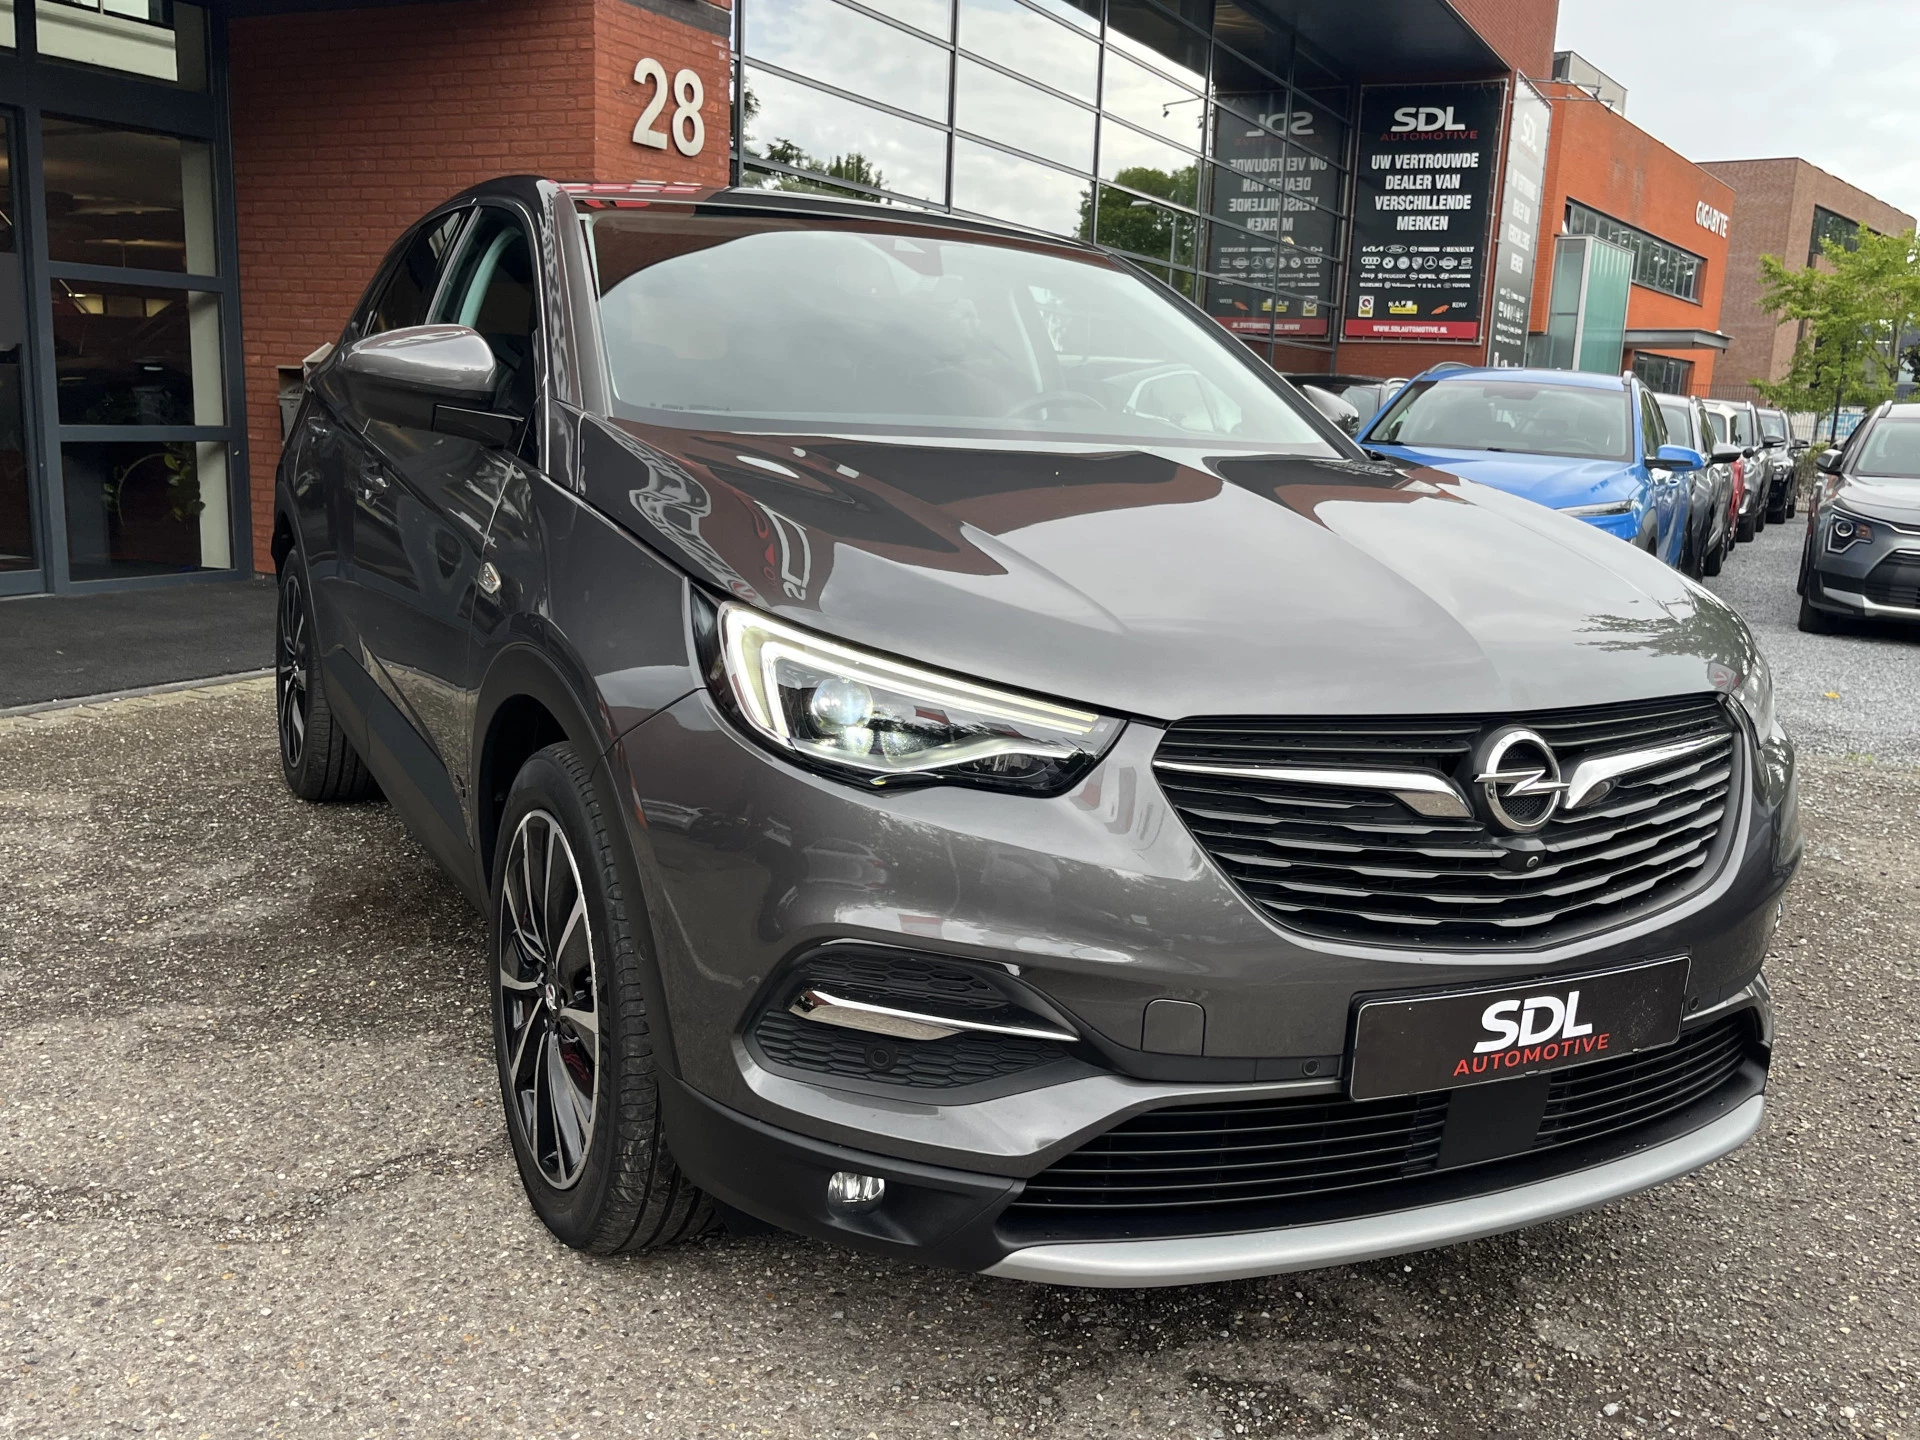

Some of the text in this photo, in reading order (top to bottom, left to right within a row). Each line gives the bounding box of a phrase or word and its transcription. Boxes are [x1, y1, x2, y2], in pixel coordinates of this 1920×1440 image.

[632, 57, 705, 157] 28
[1390, 106, 1466, 132] SDL
[1380, 130, 1478, 141] AUTOMOTIVE
[1371, 152, 1480, 170] UW VERTROUWDE
[1385, 174, 1461, 190] DEALER VAN
[1375, 194, 1472, 211] VERSCHILLENDE
[1396, 215, 1449, 231] MERKEN
[1695, 200, 1729, 239] GIGABYTE
[1372, 324, 1448, 334] WWW.SDLAUTOMOTIVE.NL
[1472, 990, 1593, 1054] SDL
[1453, 1032, 1610, 1077] AUTOMOTIVE
